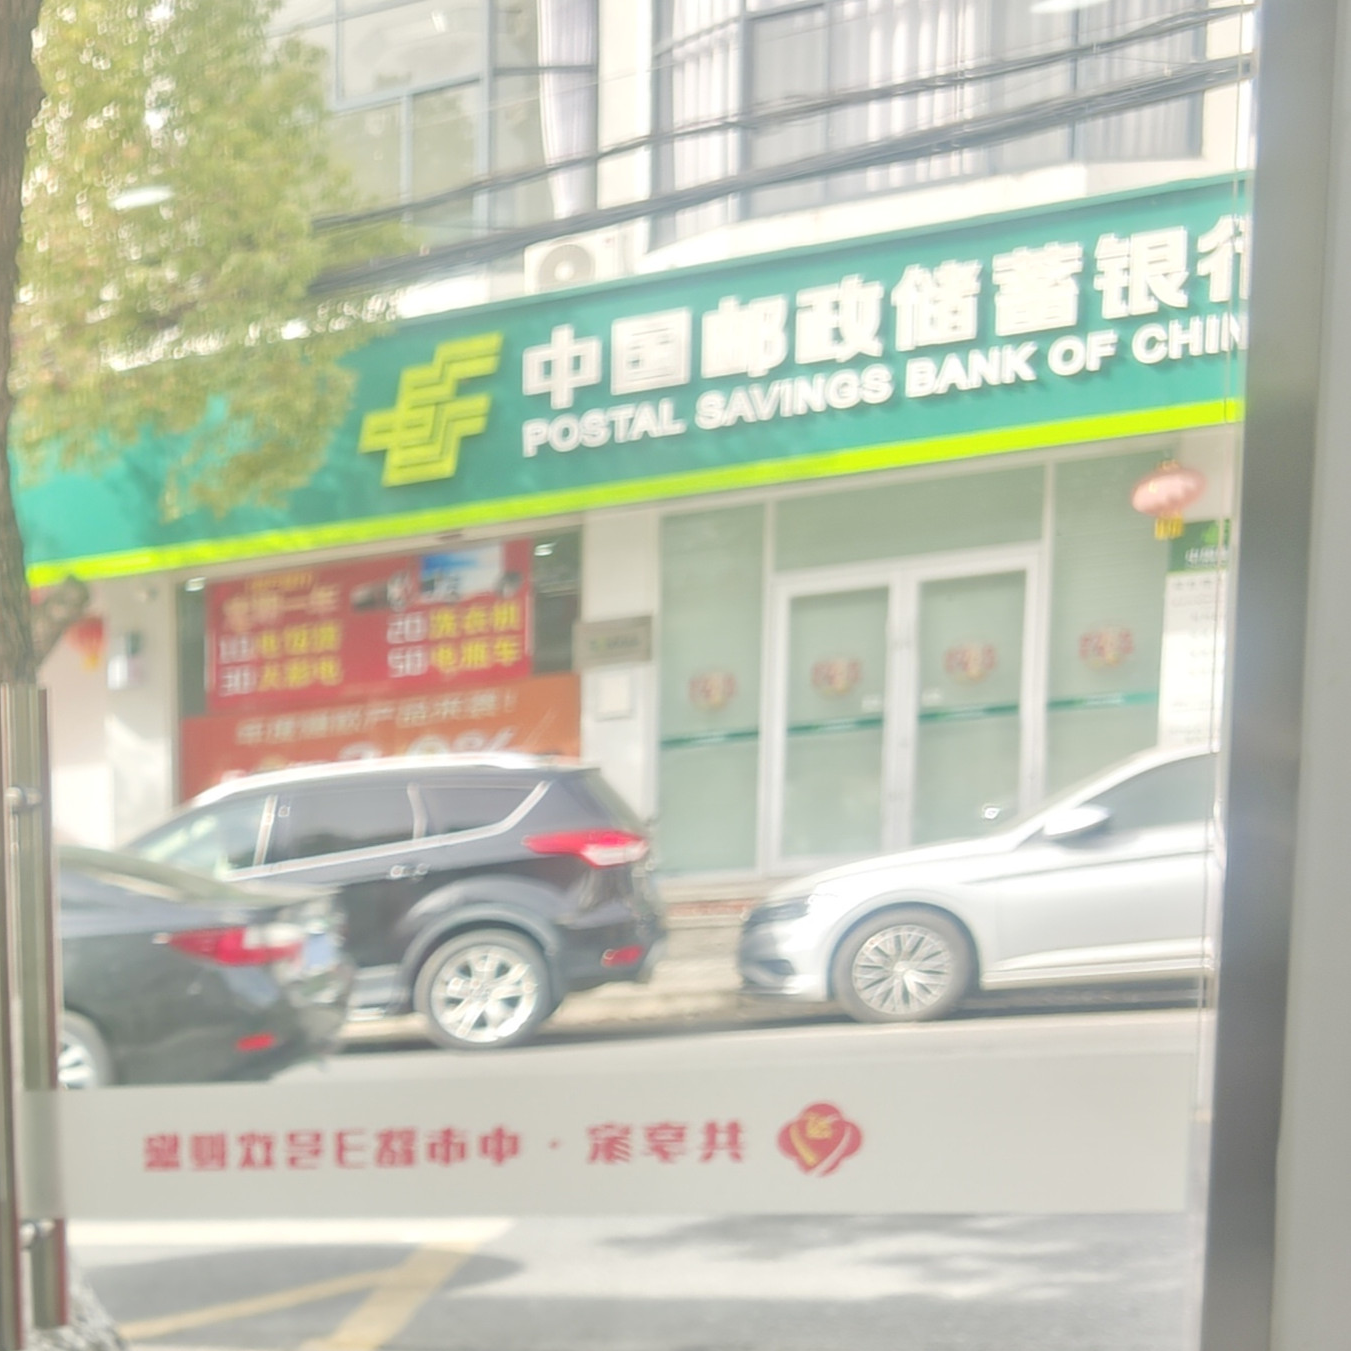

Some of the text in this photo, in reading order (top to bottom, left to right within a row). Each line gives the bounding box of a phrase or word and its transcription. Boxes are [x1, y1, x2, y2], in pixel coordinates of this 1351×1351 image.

[522, 213, 1250, 409] 中国邮政储蓄银行
[522, 397, 687, 457] POSTAL
[695, 364, 894, 430] SAVINGS
[905, 341, 1038, 398] BANK
[1048, 330, 1119, 376] OF
